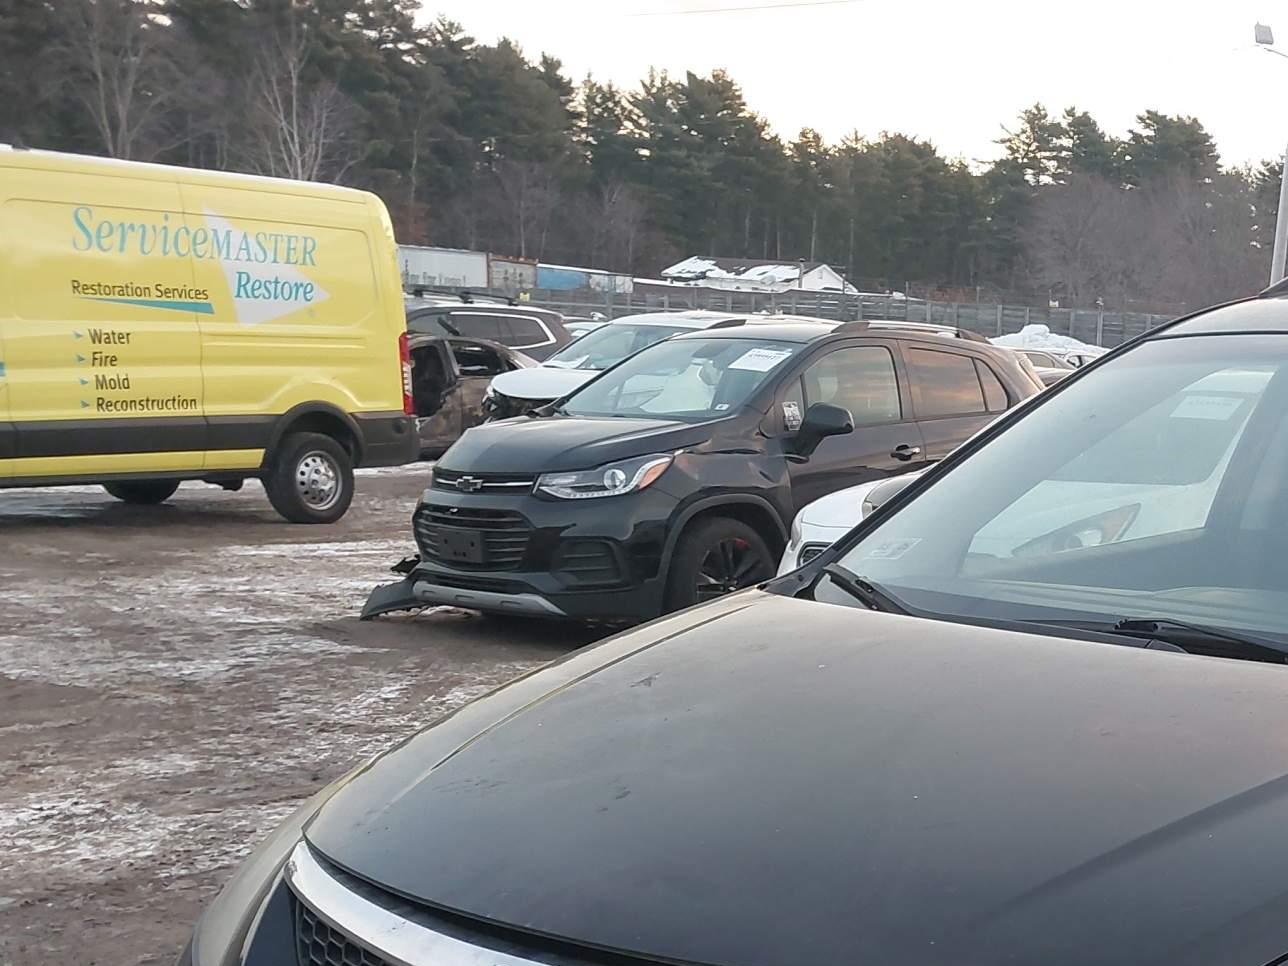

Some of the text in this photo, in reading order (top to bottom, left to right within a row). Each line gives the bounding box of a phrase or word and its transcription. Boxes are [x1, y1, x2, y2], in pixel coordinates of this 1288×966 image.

[72, 279, 209, 300] Restoration Services
[235, 271, 314, 302] Restore
[88, 329, 131, 345] Water
[92, 351, 117, 367] Fire
[95, 374, 130, 390] Mold
[96, 395, 197, 412] Reconstruction
